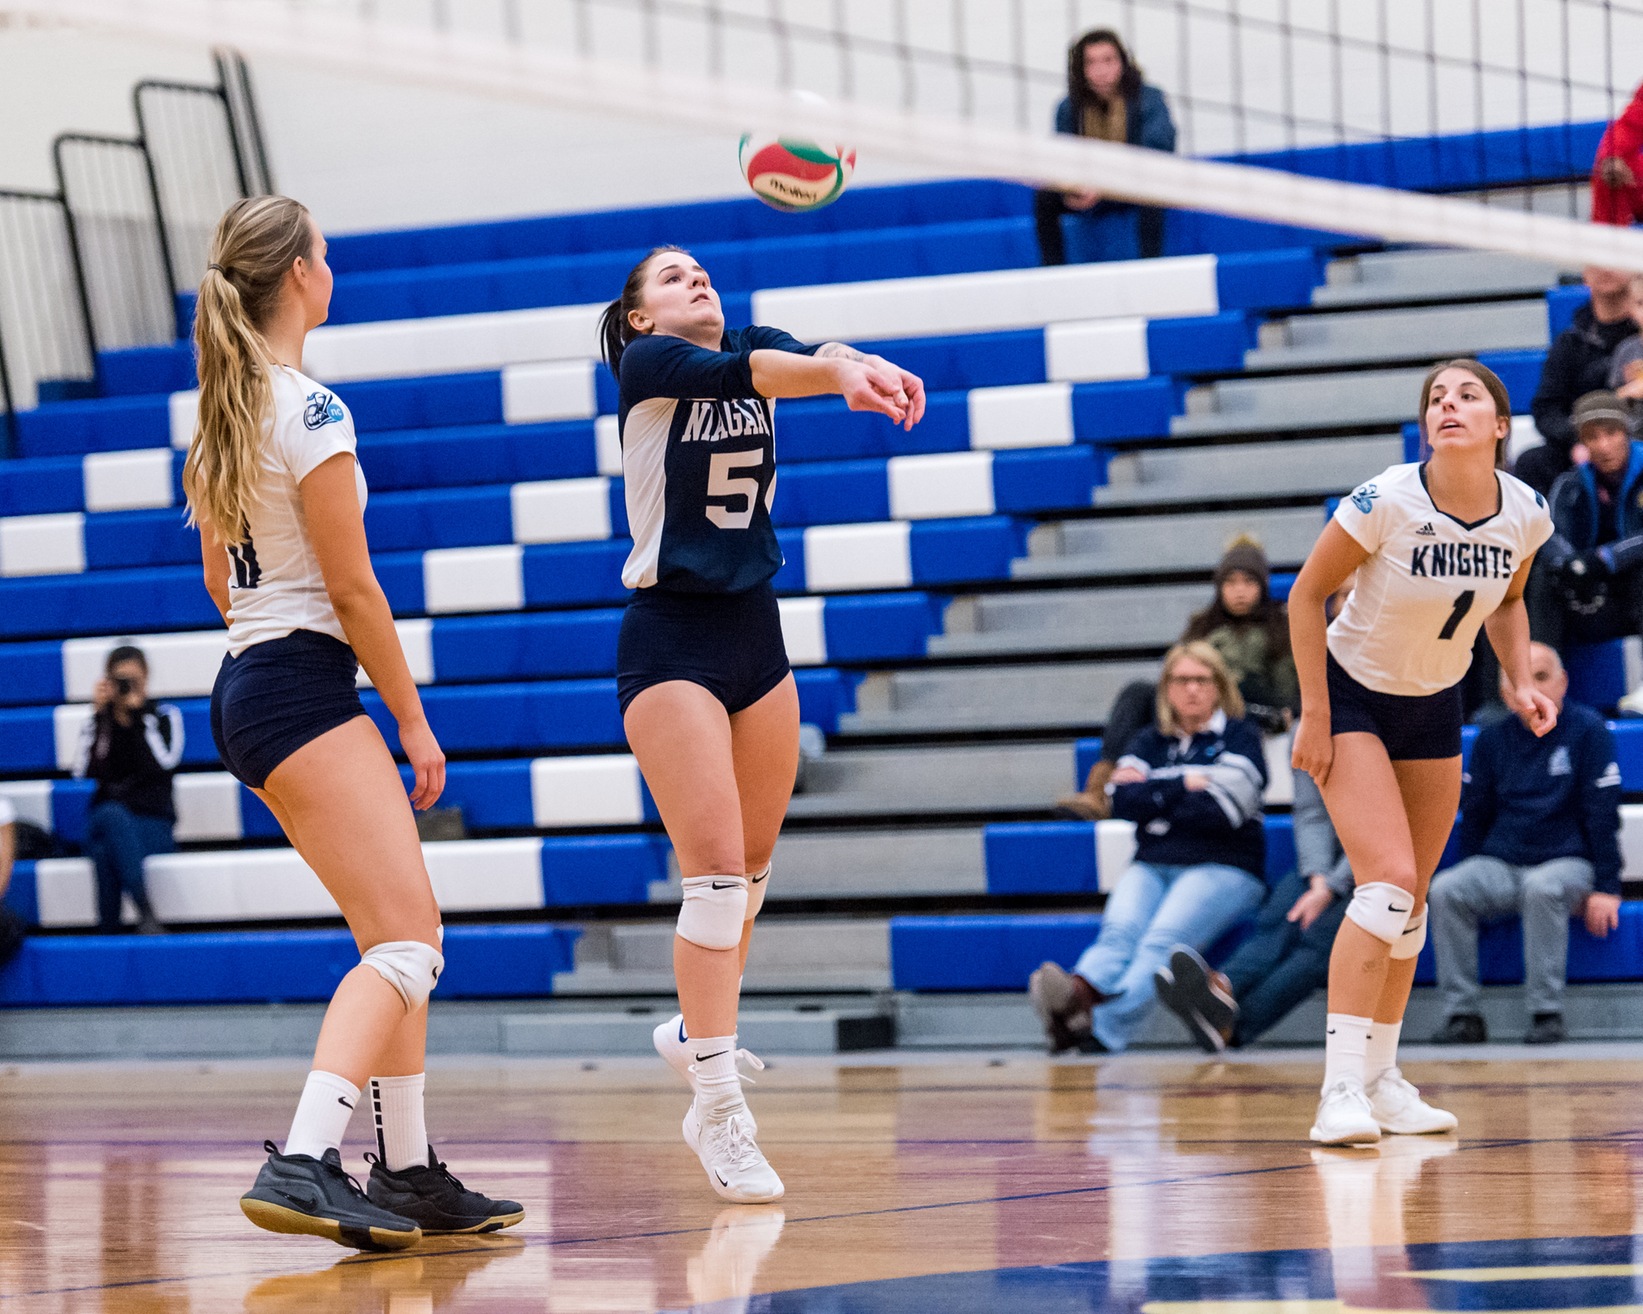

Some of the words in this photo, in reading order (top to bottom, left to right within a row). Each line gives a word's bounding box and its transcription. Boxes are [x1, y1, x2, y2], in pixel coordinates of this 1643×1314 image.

[705, 447, 764, 529] 5
[1411, 543, 1513, 579] KNIGHTS
[1437, 590, 1476, 640] 1
